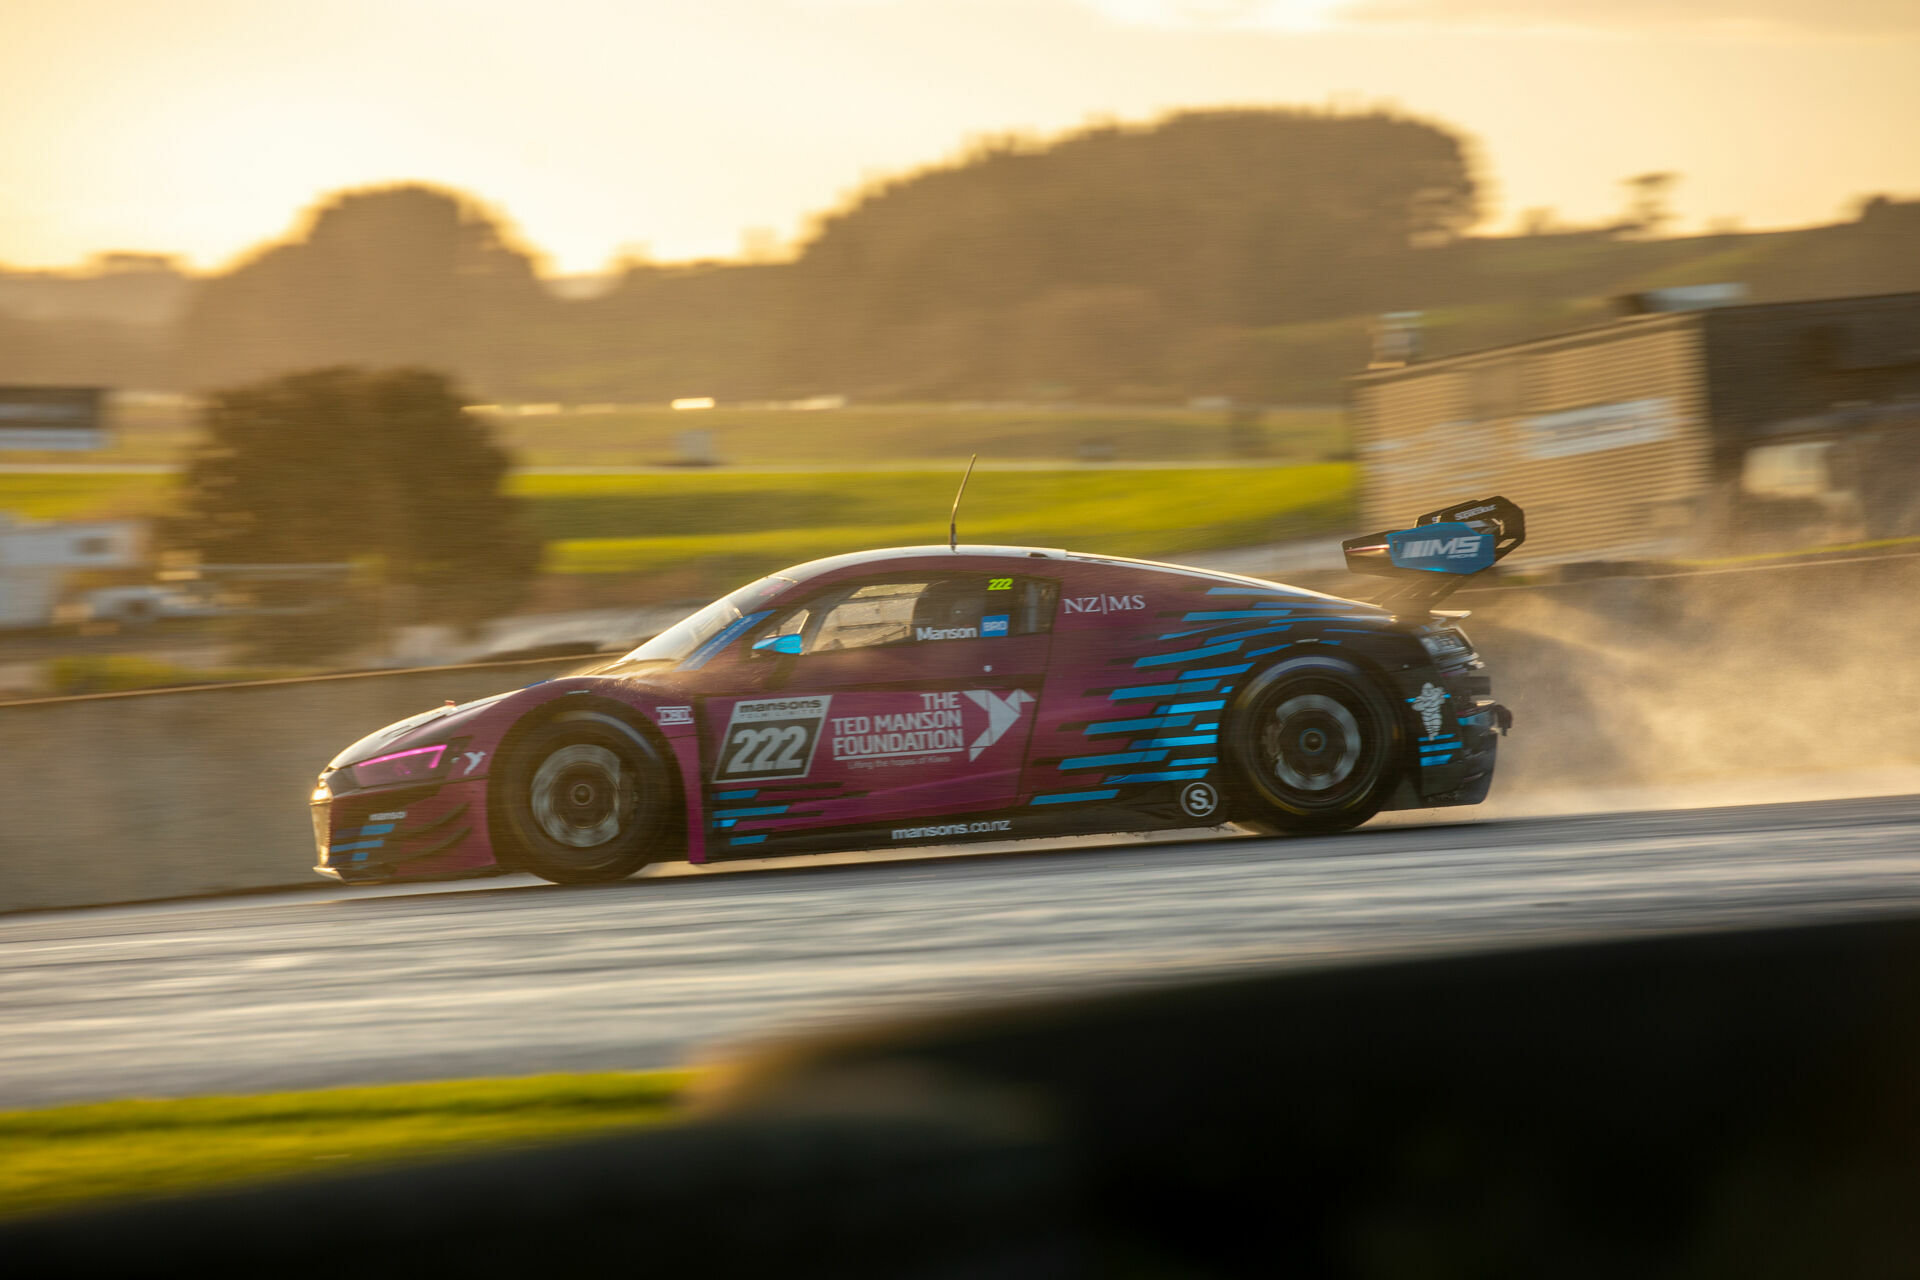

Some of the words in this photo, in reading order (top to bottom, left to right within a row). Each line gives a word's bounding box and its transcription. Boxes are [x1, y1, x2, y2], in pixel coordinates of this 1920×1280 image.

[987, 578, 1013, 591] 222
[916, 626, 977, 641] Manson
[739, 699, 822, 714] mansons
[920, 691, 961, 711] THE
[831, 716, 870, 736] TED
[874, 709, 963, 733] MANSON
[726, 725, 807, 774] 222
[832, 728, 964, 756] FOUNDATION
[891, 820, 1011, 840] mansons.co.nz
